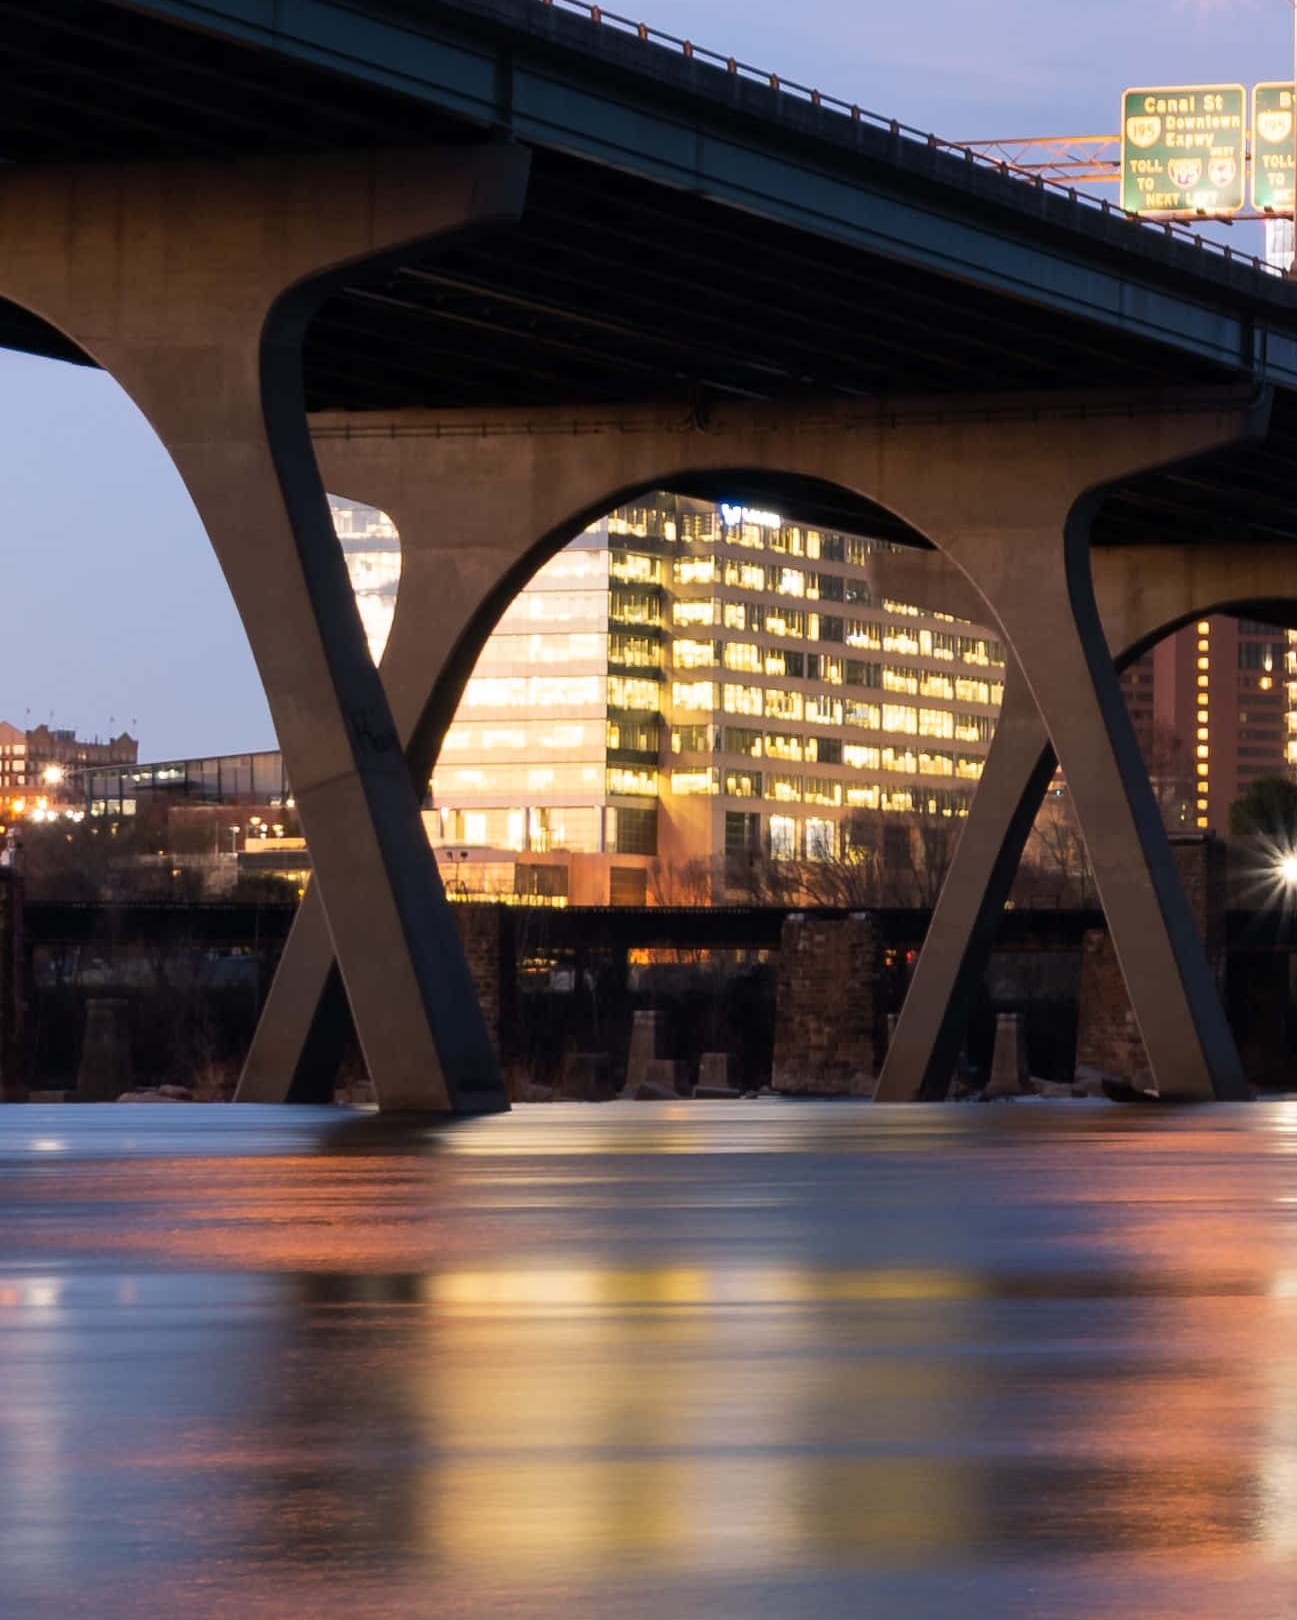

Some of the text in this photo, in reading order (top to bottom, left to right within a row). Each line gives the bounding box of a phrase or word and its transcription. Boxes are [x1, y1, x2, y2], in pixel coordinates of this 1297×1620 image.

[1144, 94, 1224, 114] Canal St
[1166, 115, 1241, 130] Downtown
[1166, 132, 1215, 149] Expwy
[1130, 159, 1163, 174] TOLL
[1262, 155, 1295, 169] TOLL
[1137, 177, 1154, 191] TO
[1267, 172, 1286, 187] TO
[1146, 193, 1180, 207] NEXT
